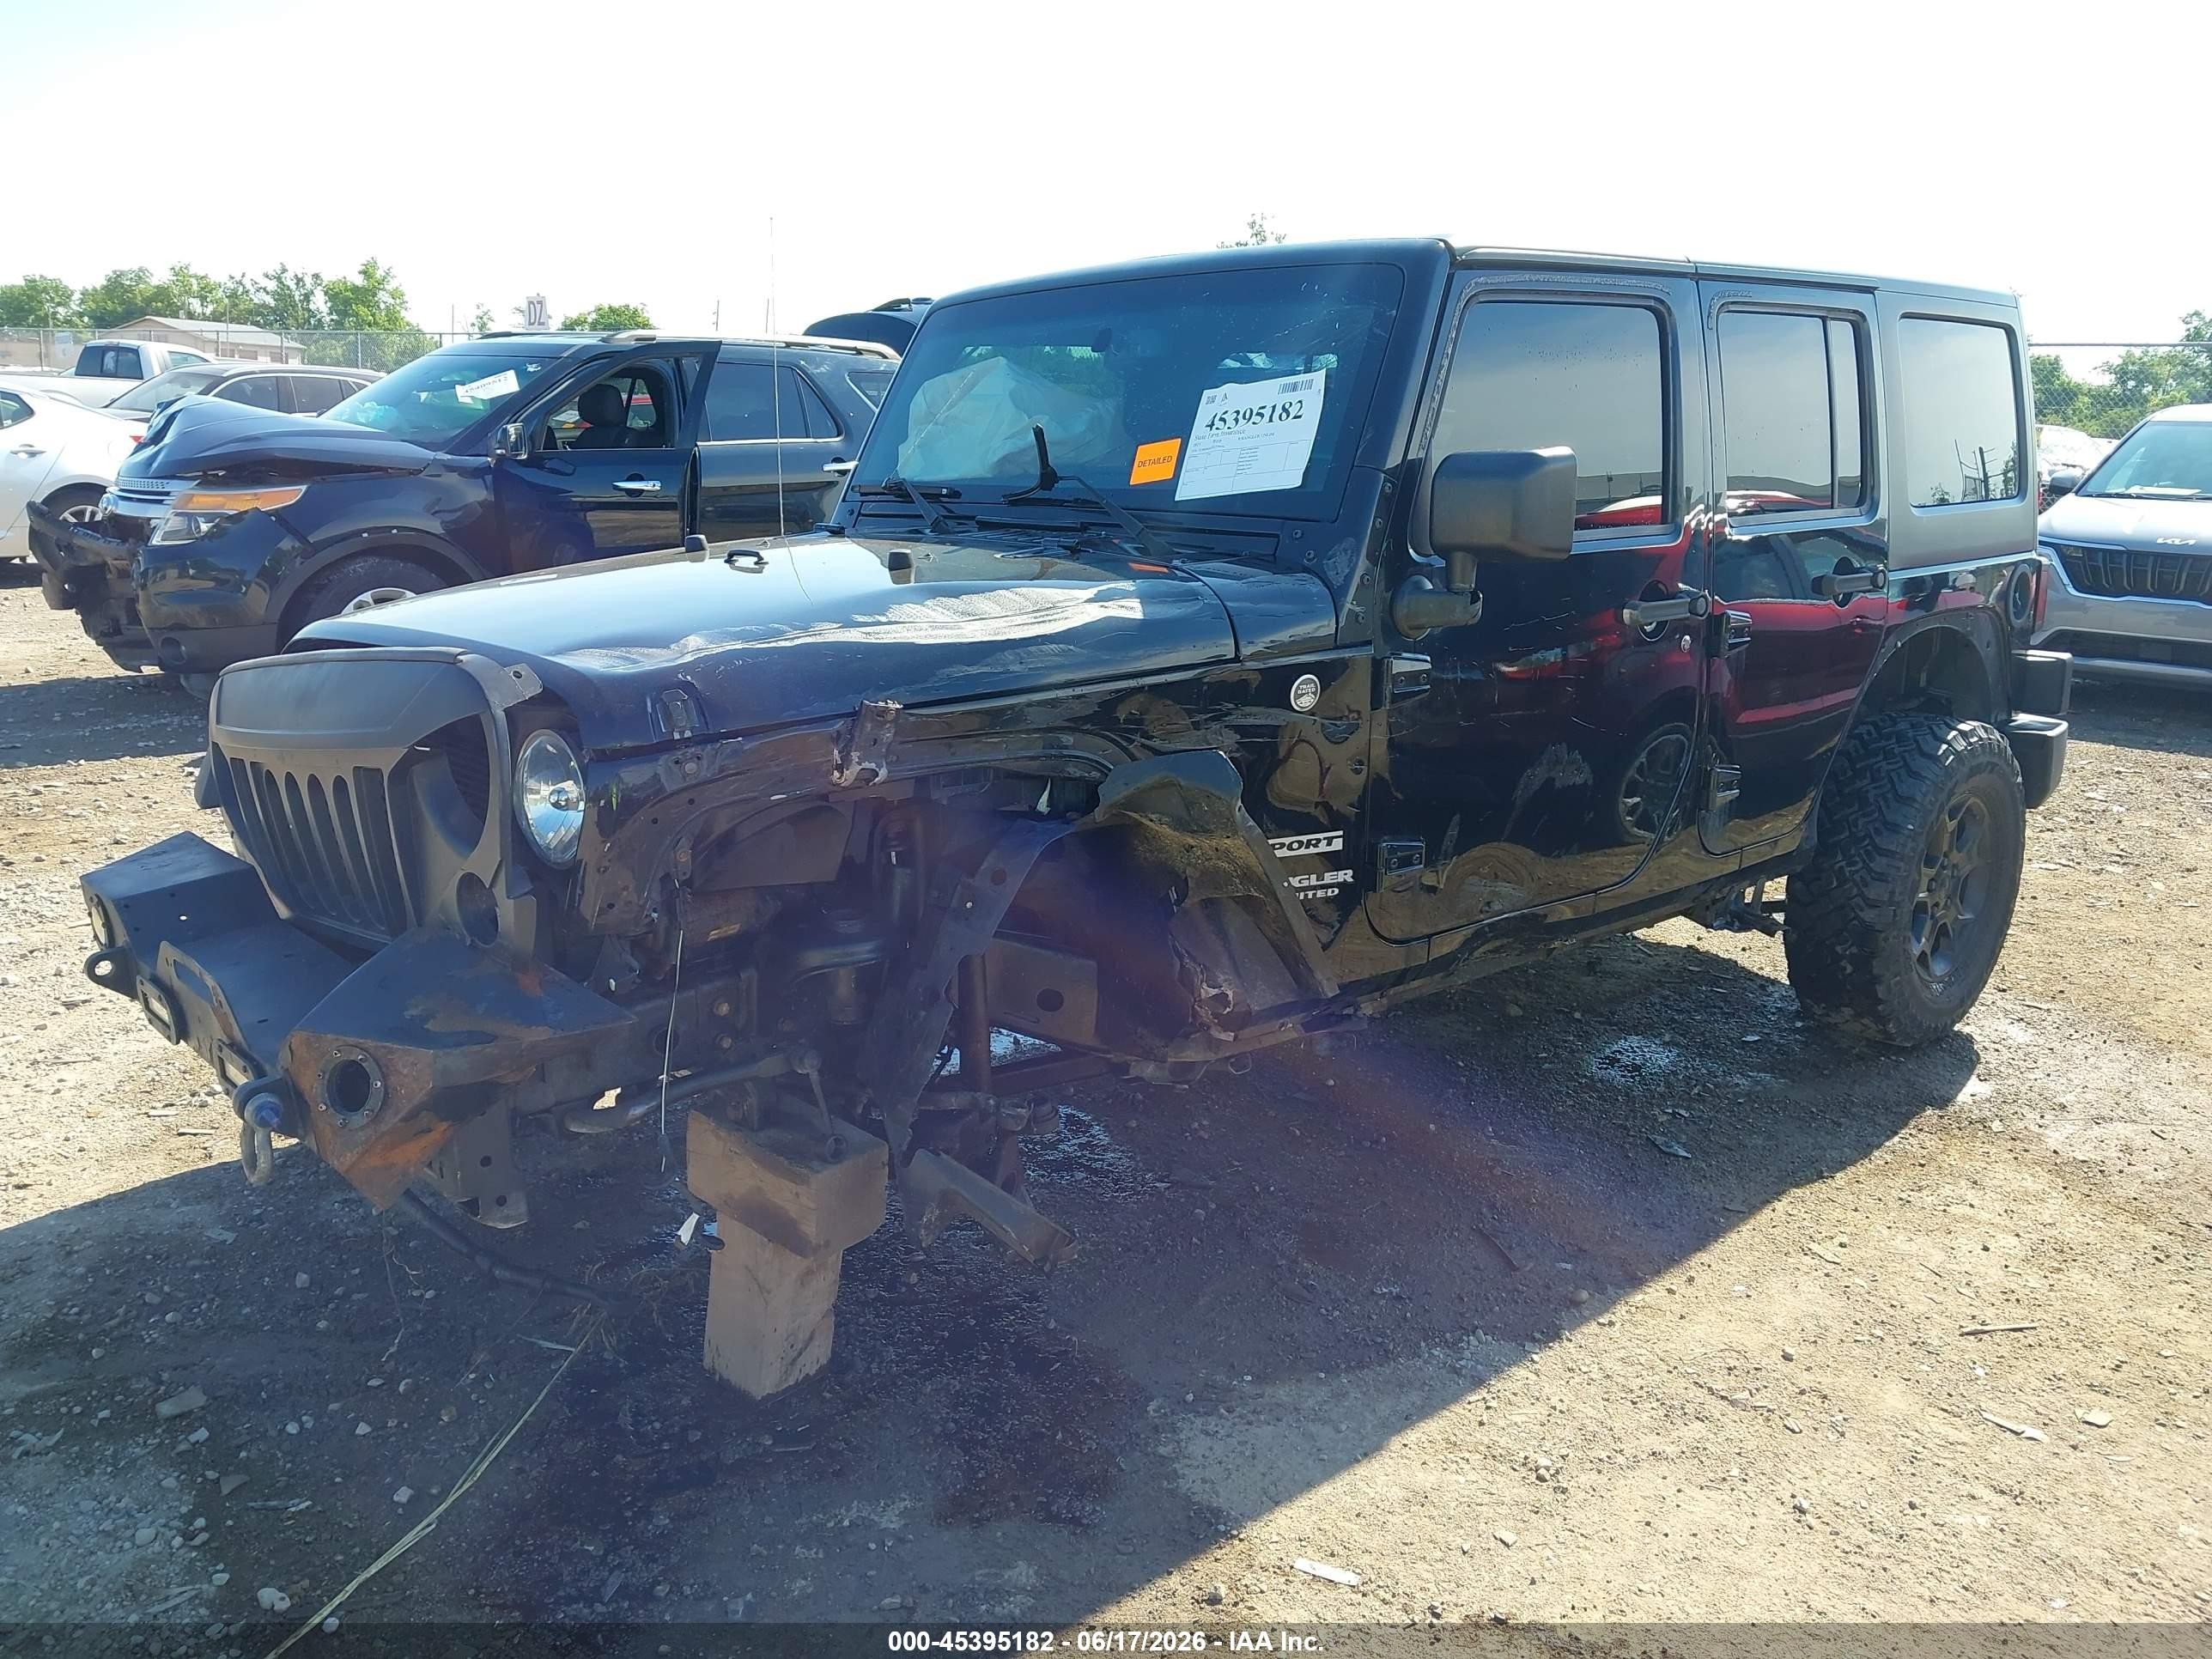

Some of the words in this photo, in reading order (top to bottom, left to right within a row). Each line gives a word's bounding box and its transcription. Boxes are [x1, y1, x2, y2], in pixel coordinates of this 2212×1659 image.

[527, 301, 545, 326] DZ
[1205, 399, 1304, 431] 45395182
[1138, 455, 1173, 468] DETAILED
[1271, 835, 1343, 852] PORT
[1288, 868, 1354, 888] GLER
[1295, 887, 1340, 900] ITED
